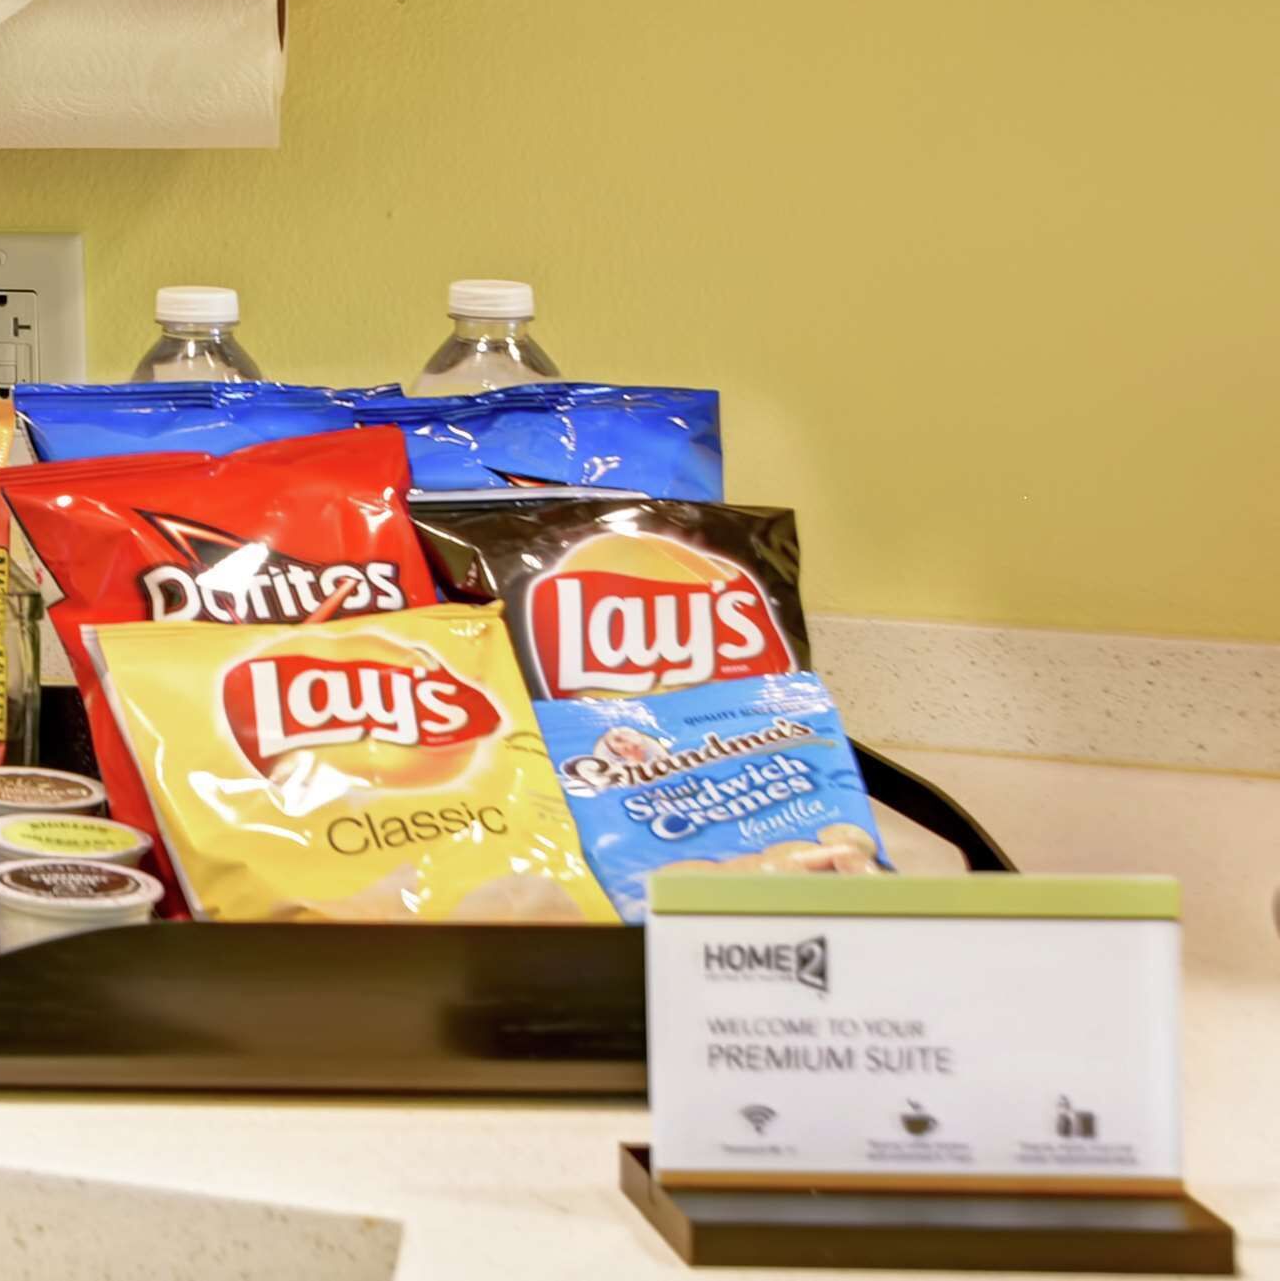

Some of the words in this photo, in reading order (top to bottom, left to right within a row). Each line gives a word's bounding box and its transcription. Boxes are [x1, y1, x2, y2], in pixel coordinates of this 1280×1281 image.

[143, 563, 405, 623] Doritos
[555, 578, 766, 692] Lay's
[249, 660, 468, 758] Lay's
[560, 716, 815, 788] Grandma's
[623, 753, 811, 821] Sandwich
[650, 775, 814, 839] Cremes
[327, 802, 508, 855] Classic
[738, 798, 825, 839] Vanilla
[707, 1018, 817, 1036] WELCOME
[829, 1018, 860, 1037] TO
[864, 1018, 925, 1037] YOUR
[707, 1043, 854, 1071] PREMIUM
[865, 1044, 954, 1073] SUITE
